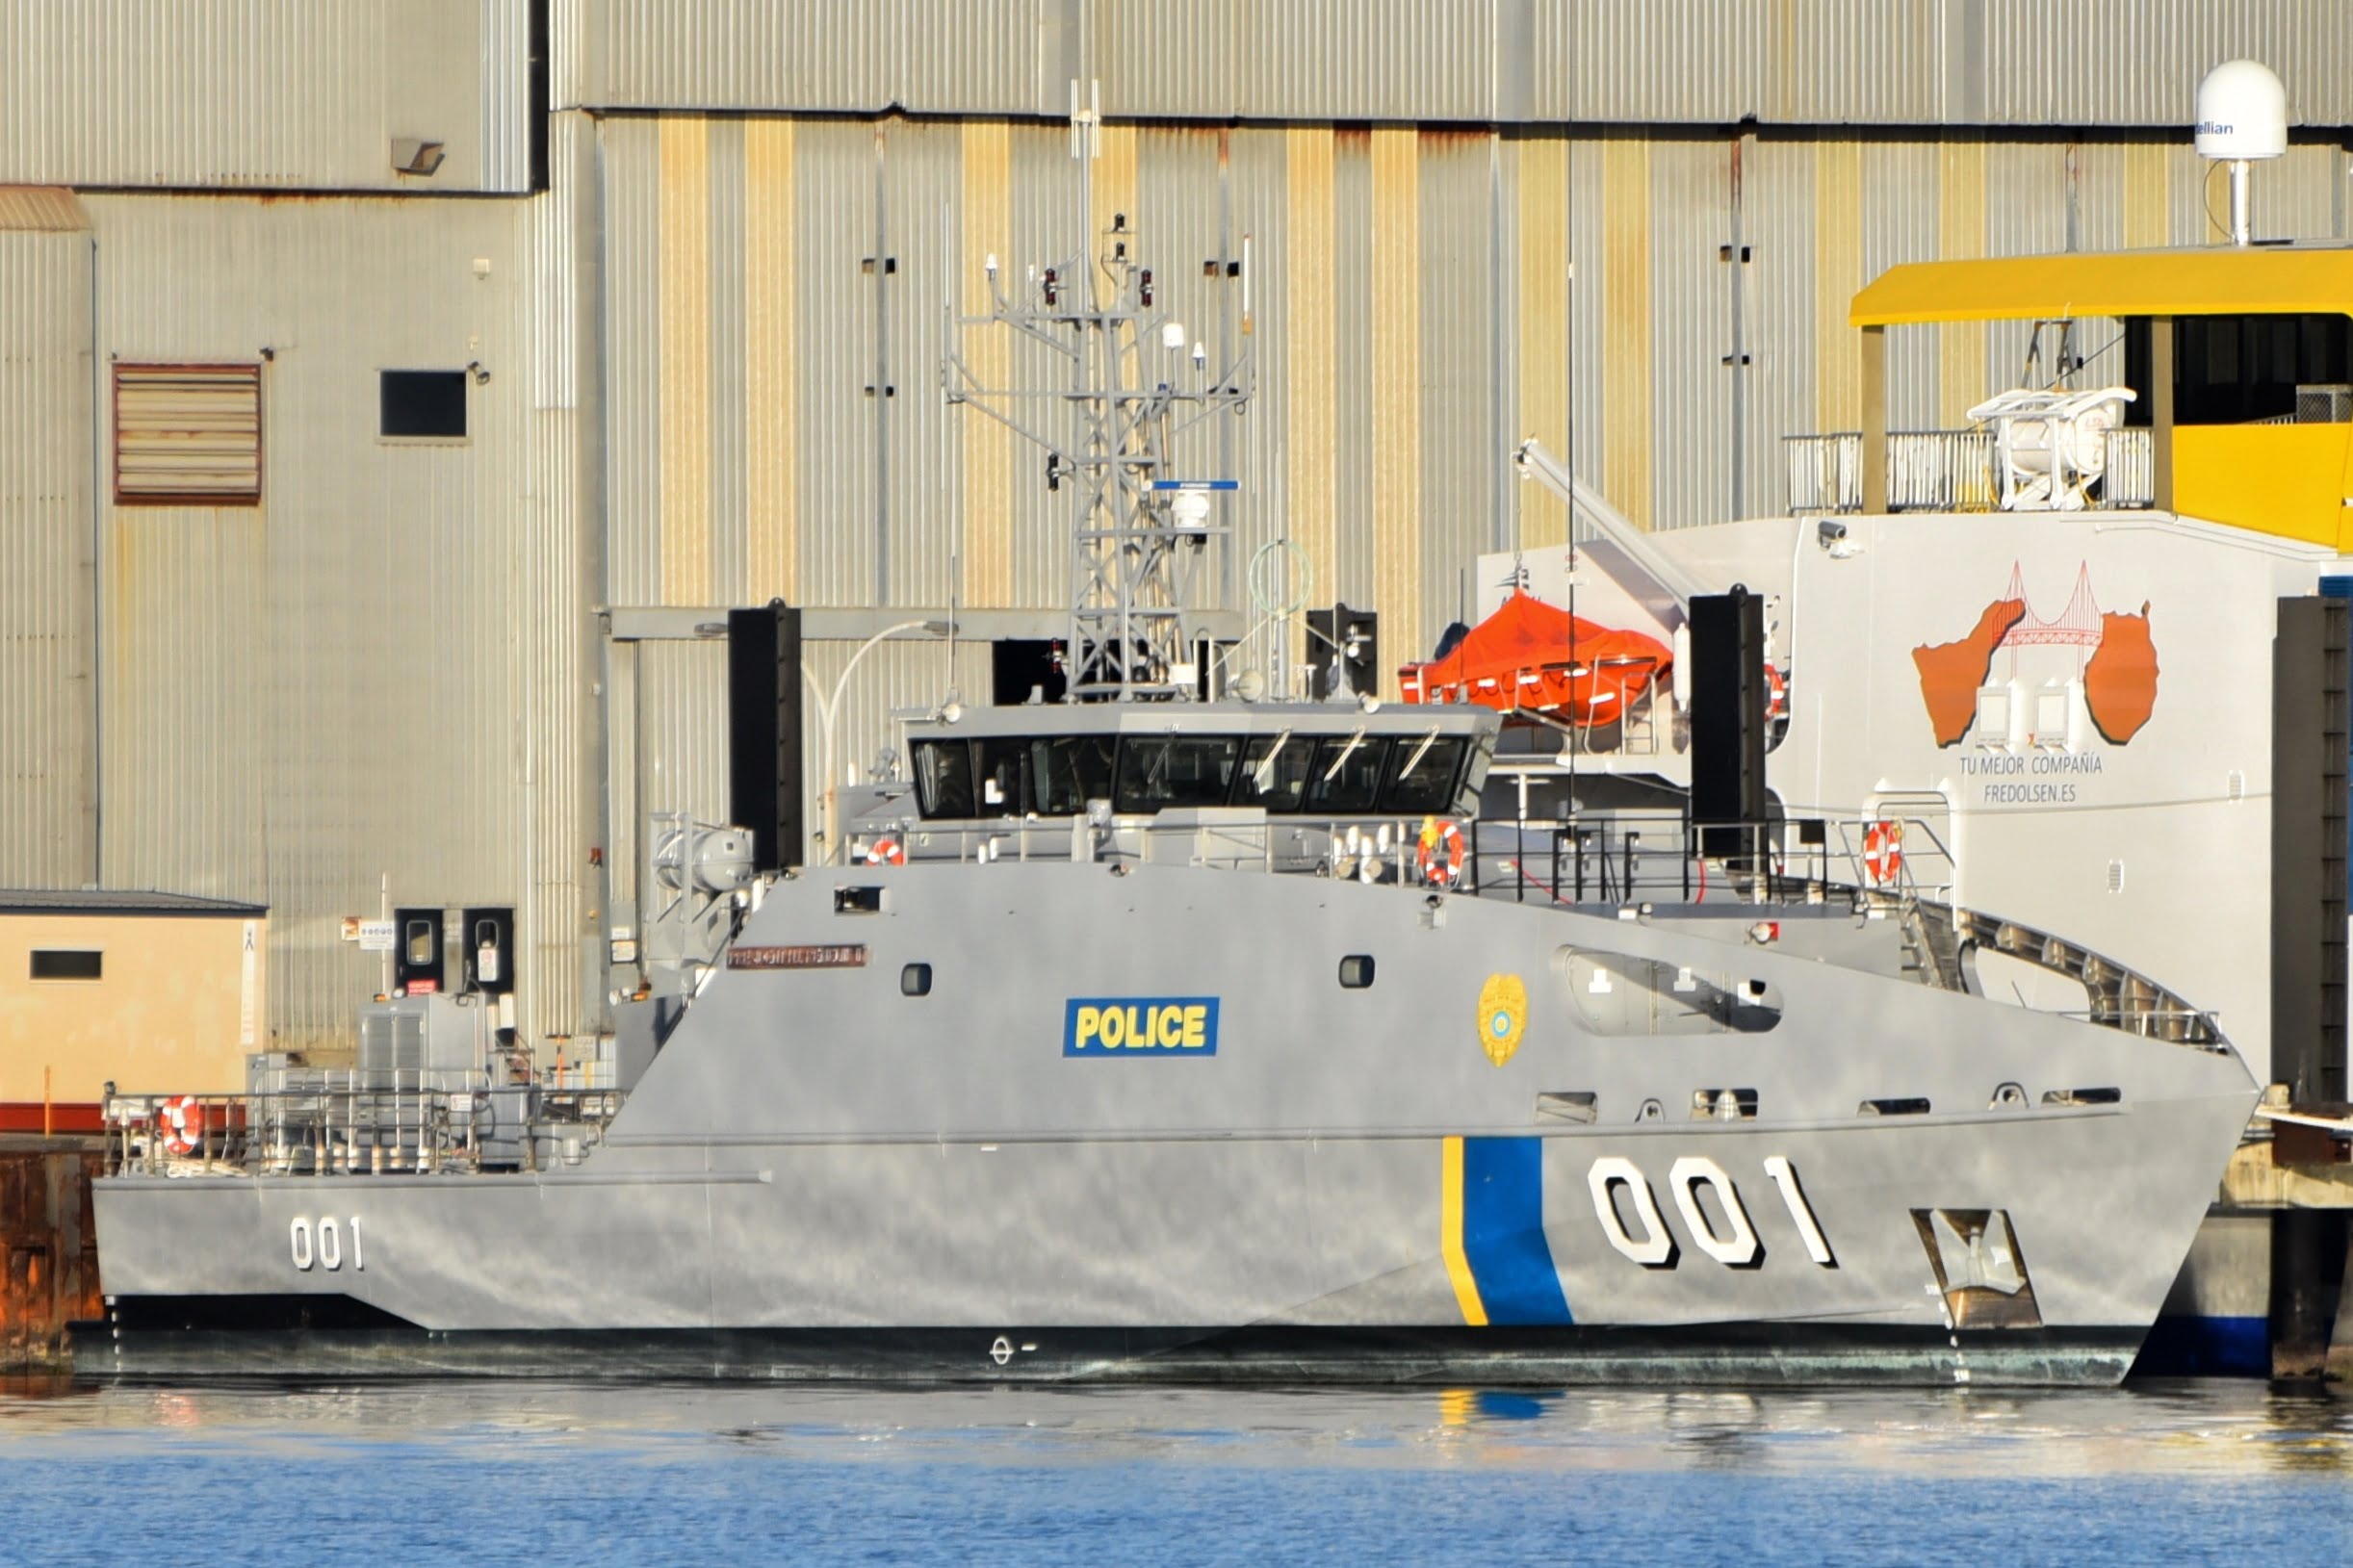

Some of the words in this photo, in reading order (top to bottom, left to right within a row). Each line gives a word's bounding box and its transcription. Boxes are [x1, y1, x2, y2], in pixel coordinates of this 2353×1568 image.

[1960, 757, 1977, 775] TU
[1980, 756, 2024, 775] MEJOR
[2031, 752, 2103, 775] COMPAÑÍA
[1984, 784, 2076, 803] FREDOLSEN.ES
[1075, 1005, 1206, 1049] POLICE
[1588, 1155, 1832, 1264] 001
[290, 1217, 363, 1270] 001
